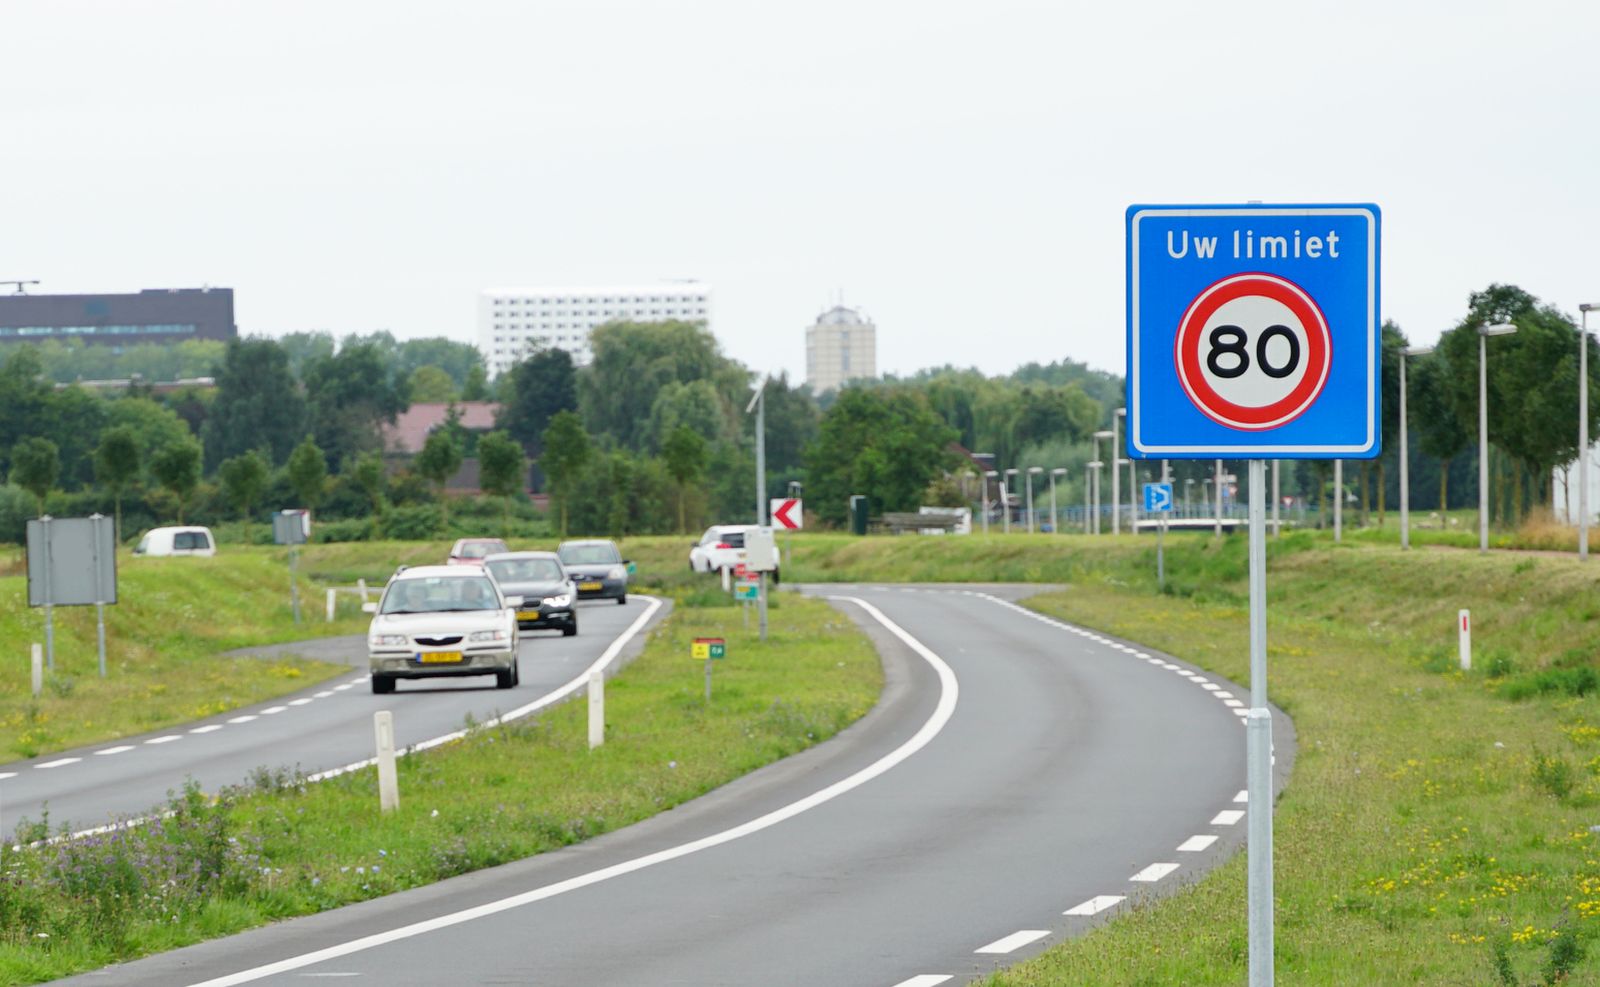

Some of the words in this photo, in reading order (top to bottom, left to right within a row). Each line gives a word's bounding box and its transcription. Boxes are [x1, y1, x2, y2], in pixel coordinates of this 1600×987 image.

[1167, 230, 1218, 259] Uw
[1233, 230, 1340, 259] limiet
[1206, 324, 1300, 379] 80
